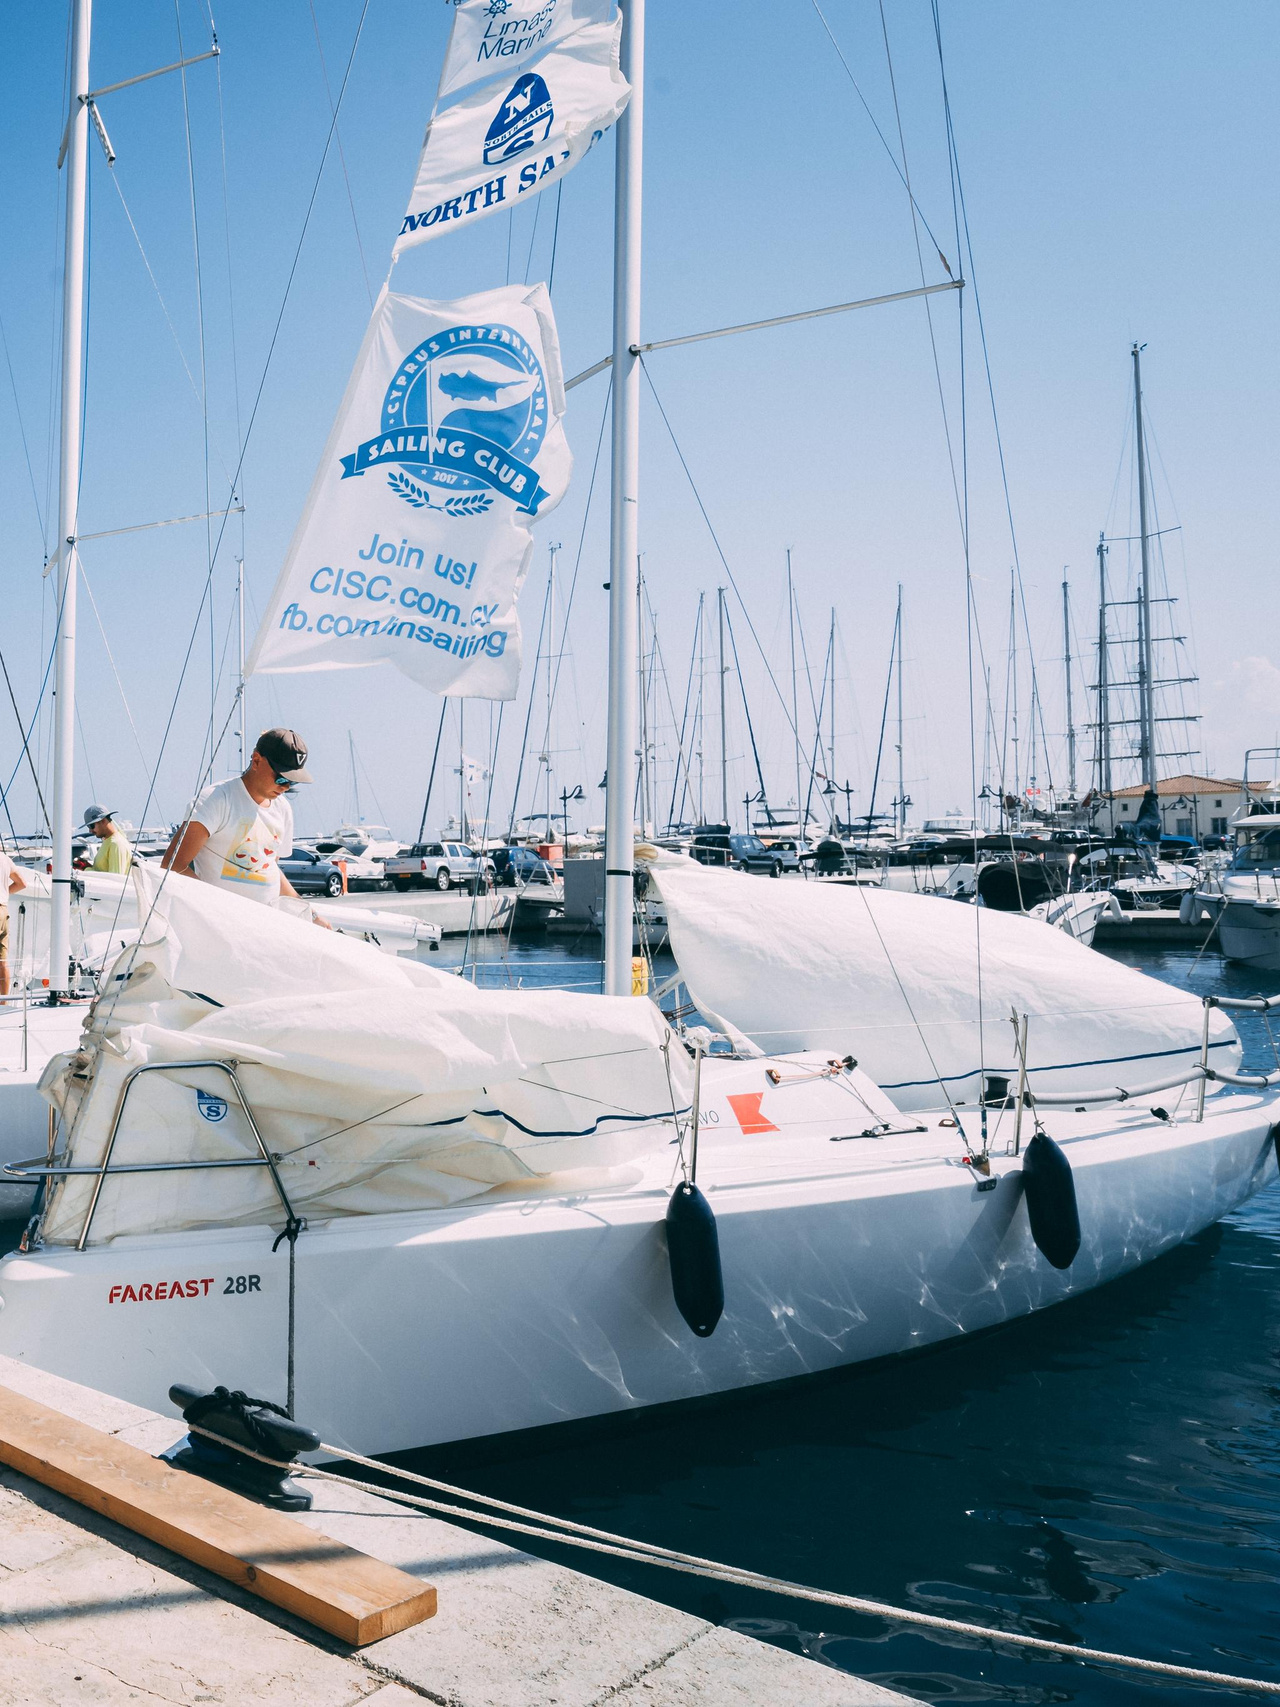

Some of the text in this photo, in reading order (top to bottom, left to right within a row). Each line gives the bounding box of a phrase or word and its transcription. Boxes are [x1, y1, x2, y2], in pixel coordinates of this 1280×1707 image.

[477, 19, 552, 62] Marina
[483, 101, 553, 149] NORTH SAILS
[398, 175, 507, 236] NORTH
[387, 341, 441, 414] CYPRUS
[368, 435, 527, 494] SAILING CLUB
[432, 471, 458, 485] 2017
[359, 533, 477, 590] Join us!
[310, 567, 499, 629] CISC.com.cy
[279, 603, 508, 660] fb.com/insailing
[207, 1105, 220, 1117] S
[108, 1274, 261, 1304] FAREAST 28R
